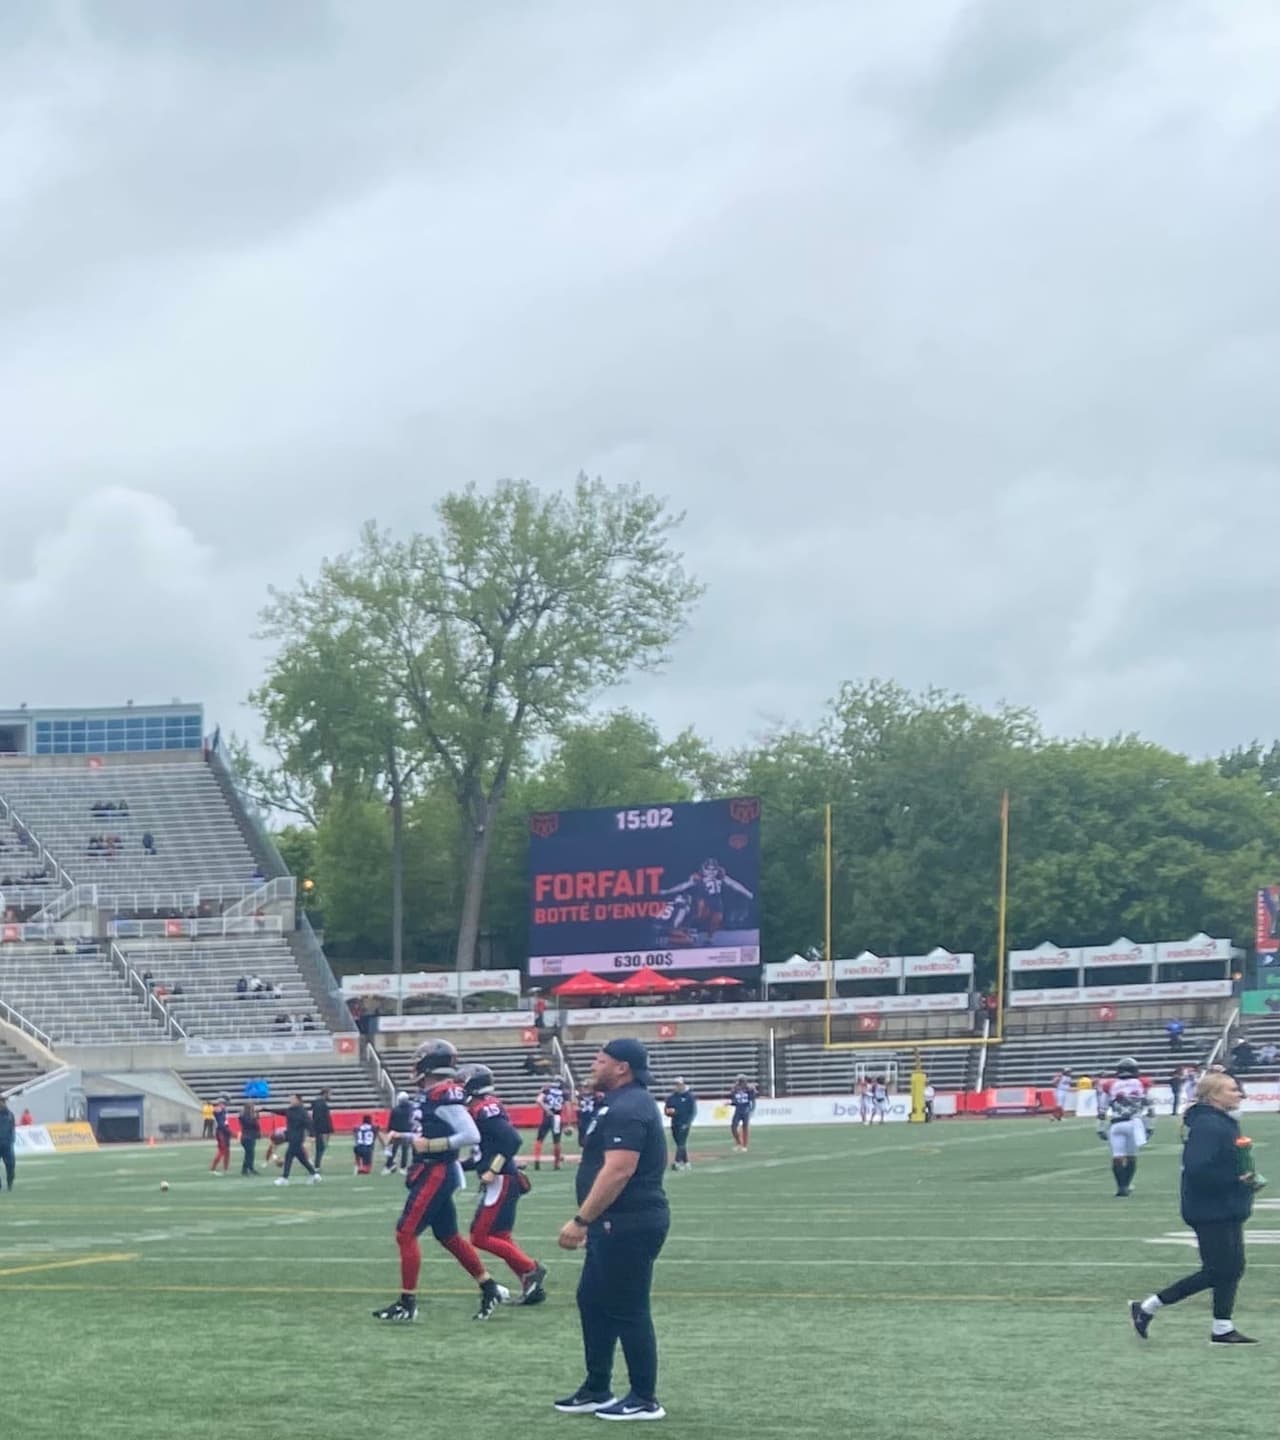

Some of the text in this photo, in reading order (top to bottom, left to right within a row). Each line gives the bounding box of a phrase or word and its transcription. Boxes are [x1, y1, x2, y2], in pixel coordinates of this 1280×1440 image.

[615, 808, 673, 830] 15:02
[534, 867, 664, 901] FORFAIT
[534, 903, 590, 924] BOTTÉ
[613, 953, 673, 968] 630.00$
[483, 1103, 500, 1119] 15
[356, 1130, 374, 1147] 19
